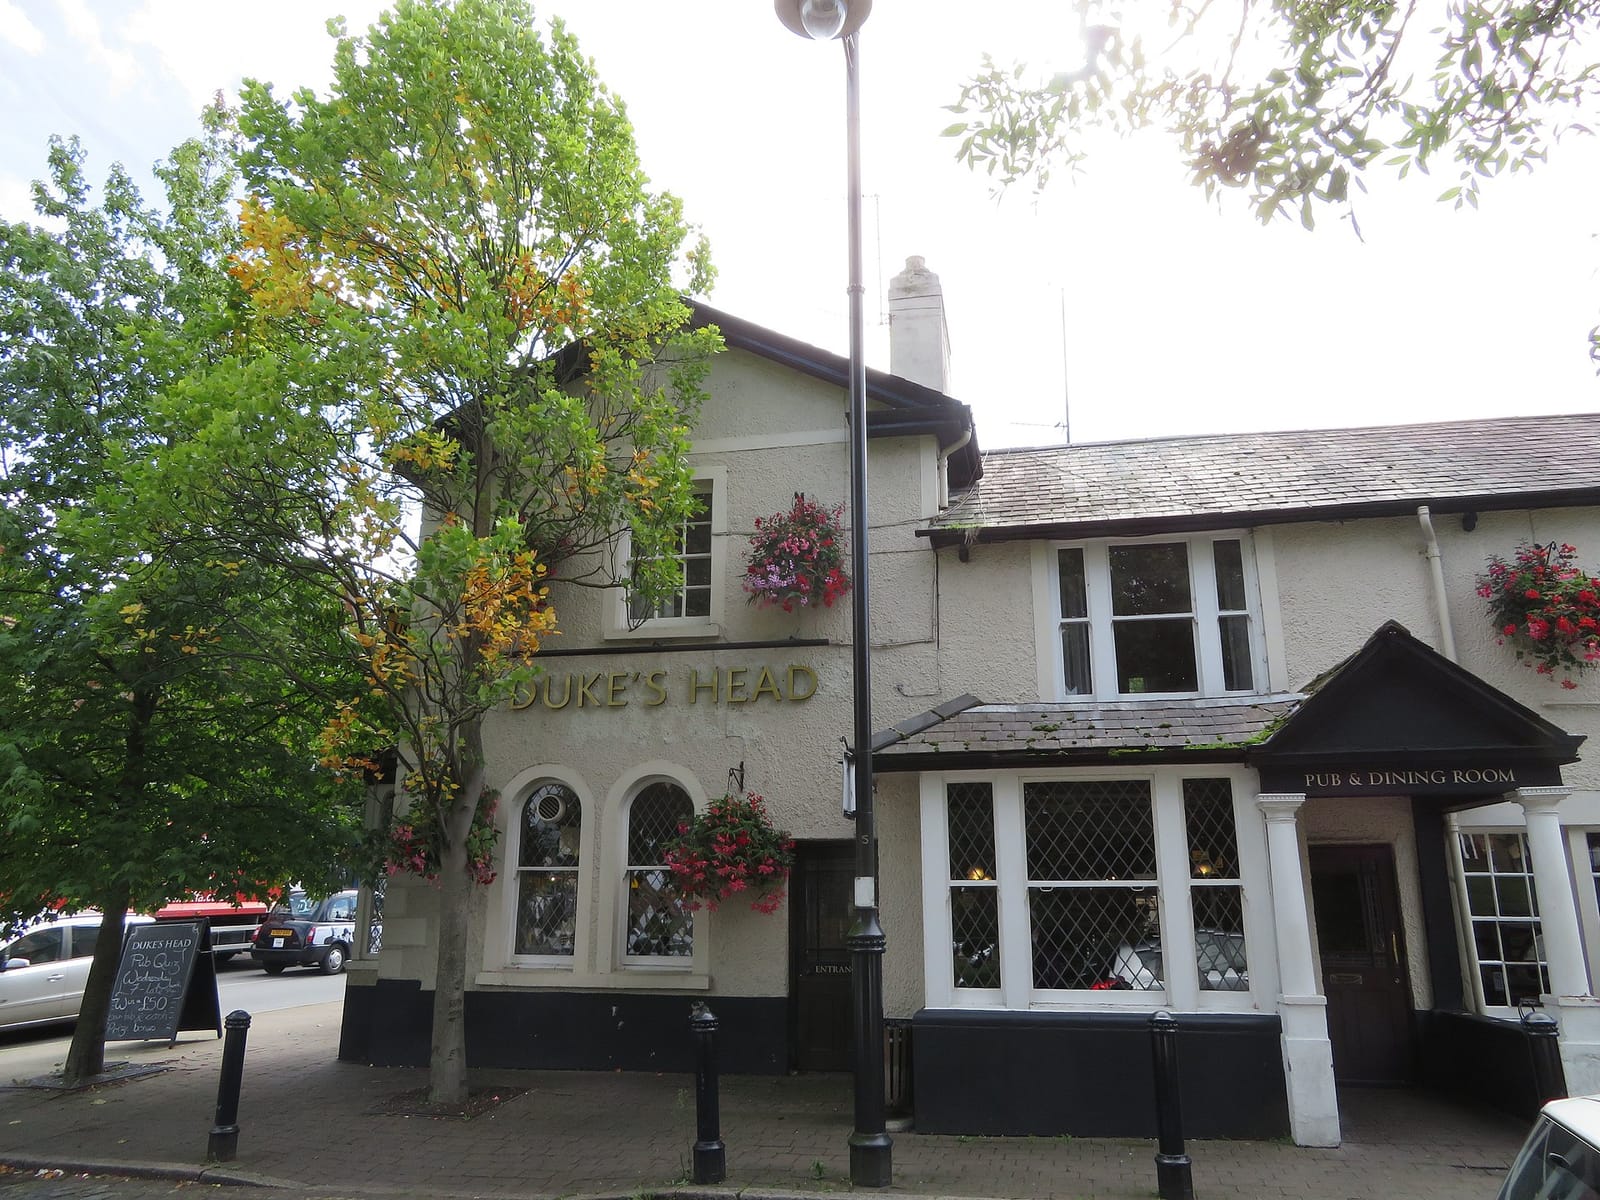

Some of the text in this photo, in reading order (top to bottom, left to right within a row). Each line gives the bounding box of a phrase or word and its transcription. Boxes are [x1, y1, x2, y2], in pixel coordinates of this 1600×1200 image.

[510, 664, 819, 710] DUKE'S HEAD
[1305, 768, 1516, 787] PUB & DINING ROOM
[165, 939, 192, 948] HEAD
[130, 952, 180, 975] Pub Quiz
[815, 965, 853, 974] ENTRAN
